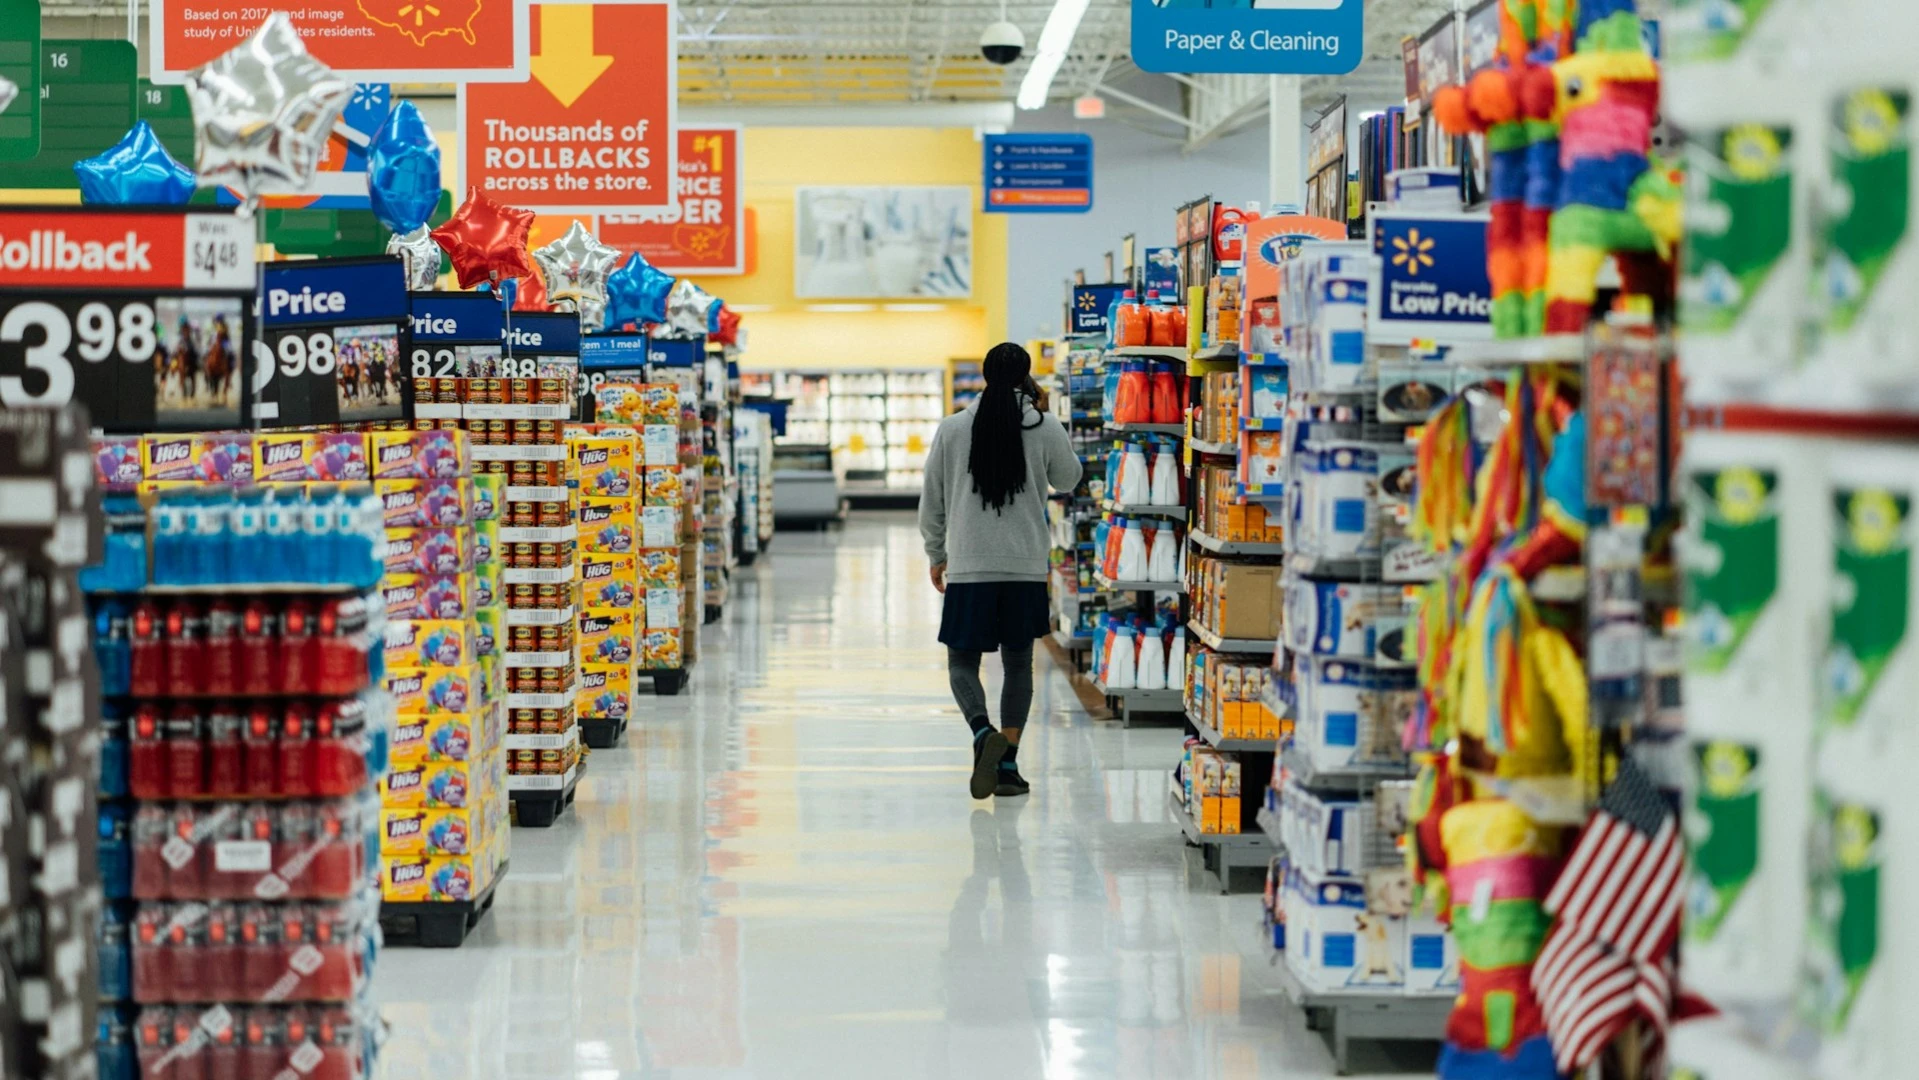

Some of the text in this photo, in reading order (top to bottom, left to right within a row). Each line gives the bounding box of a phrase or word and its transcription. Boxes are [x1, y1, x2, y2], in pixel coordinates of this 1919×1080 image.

[184, 8, 220, 20] Based
[222, 11, 237, 20] on
[241, 8, 267, 20] 2017
[308, 10, 344, 24] image
[184, 27, 216, 40] study
[219, 26, 233, 37] of
[318, 26, 376, 37] residents.
[1165, 30, 1339, 56] Paper & Cleaning
[51, 53, 68, 68] 16
[145, 90, 162, 104] 18
[484, 119, 649, 142] Thousands of
[484, 147, 651, 169] ROLLBACKS
[484, 172, 652, 190] across the store.
[269, 286, 346, 316] Price
[1390, 292, 1440, 314] Low
[1079, 317, 1099, 327] Low
[617, 339, 641, 349] meal
[412, 349, 456, 378] 82
[502, 358, 537, 378] 88
[579, 372, 605, 396] 98
[156, 444, 190, 463] HUG
[267, 444, 301, 463] HUG
[383, 445, 411, 462] HUG
[582, 451, 607, 465] HUG
[387, 492, 415, 509] HUG
[586, 564, 611, 578] HUG
[388, 585, 416, 604] HUG
[392, 679, 421, 696] HUG
[583, 675, 605, 688] HUG
[394, 726, 423, 743] HUG
[390, 772, 420, 789] HUG
[390, 820, 420, 837] HUG
[394, 865, 423, 883] HUG
